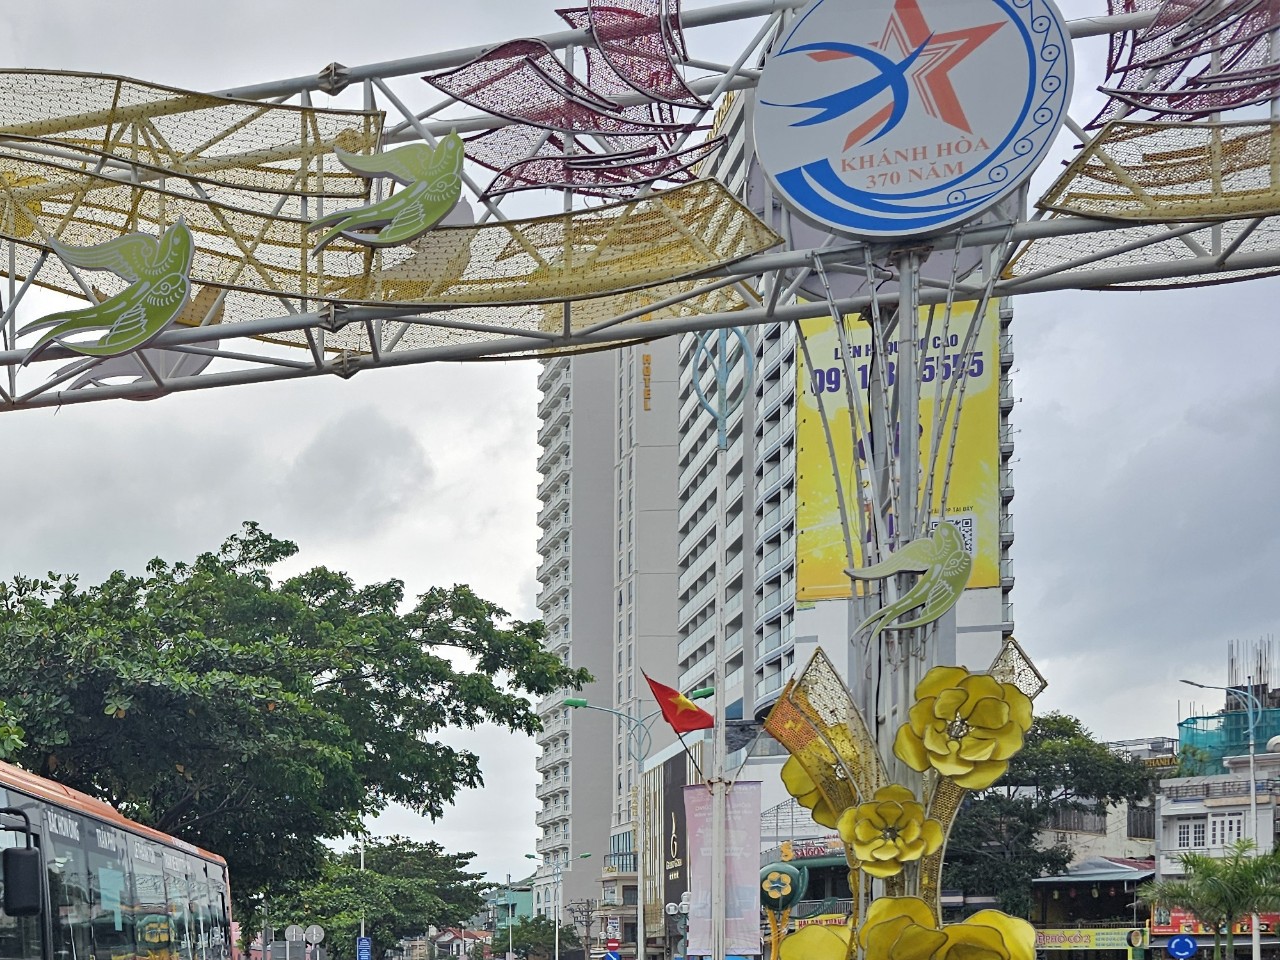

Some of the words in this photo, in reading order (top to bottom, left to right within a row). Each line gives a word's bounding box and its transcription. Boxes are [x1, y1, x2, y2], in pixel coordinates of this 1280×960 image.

[841, 146, 928, 172] KHÁNH
[936, 135, 990, 158] HÒA
[866, 171, 901, 189] 370
[908, 161, 964, 183] NĂM
[642, 353, 652, 411] HOTEL
